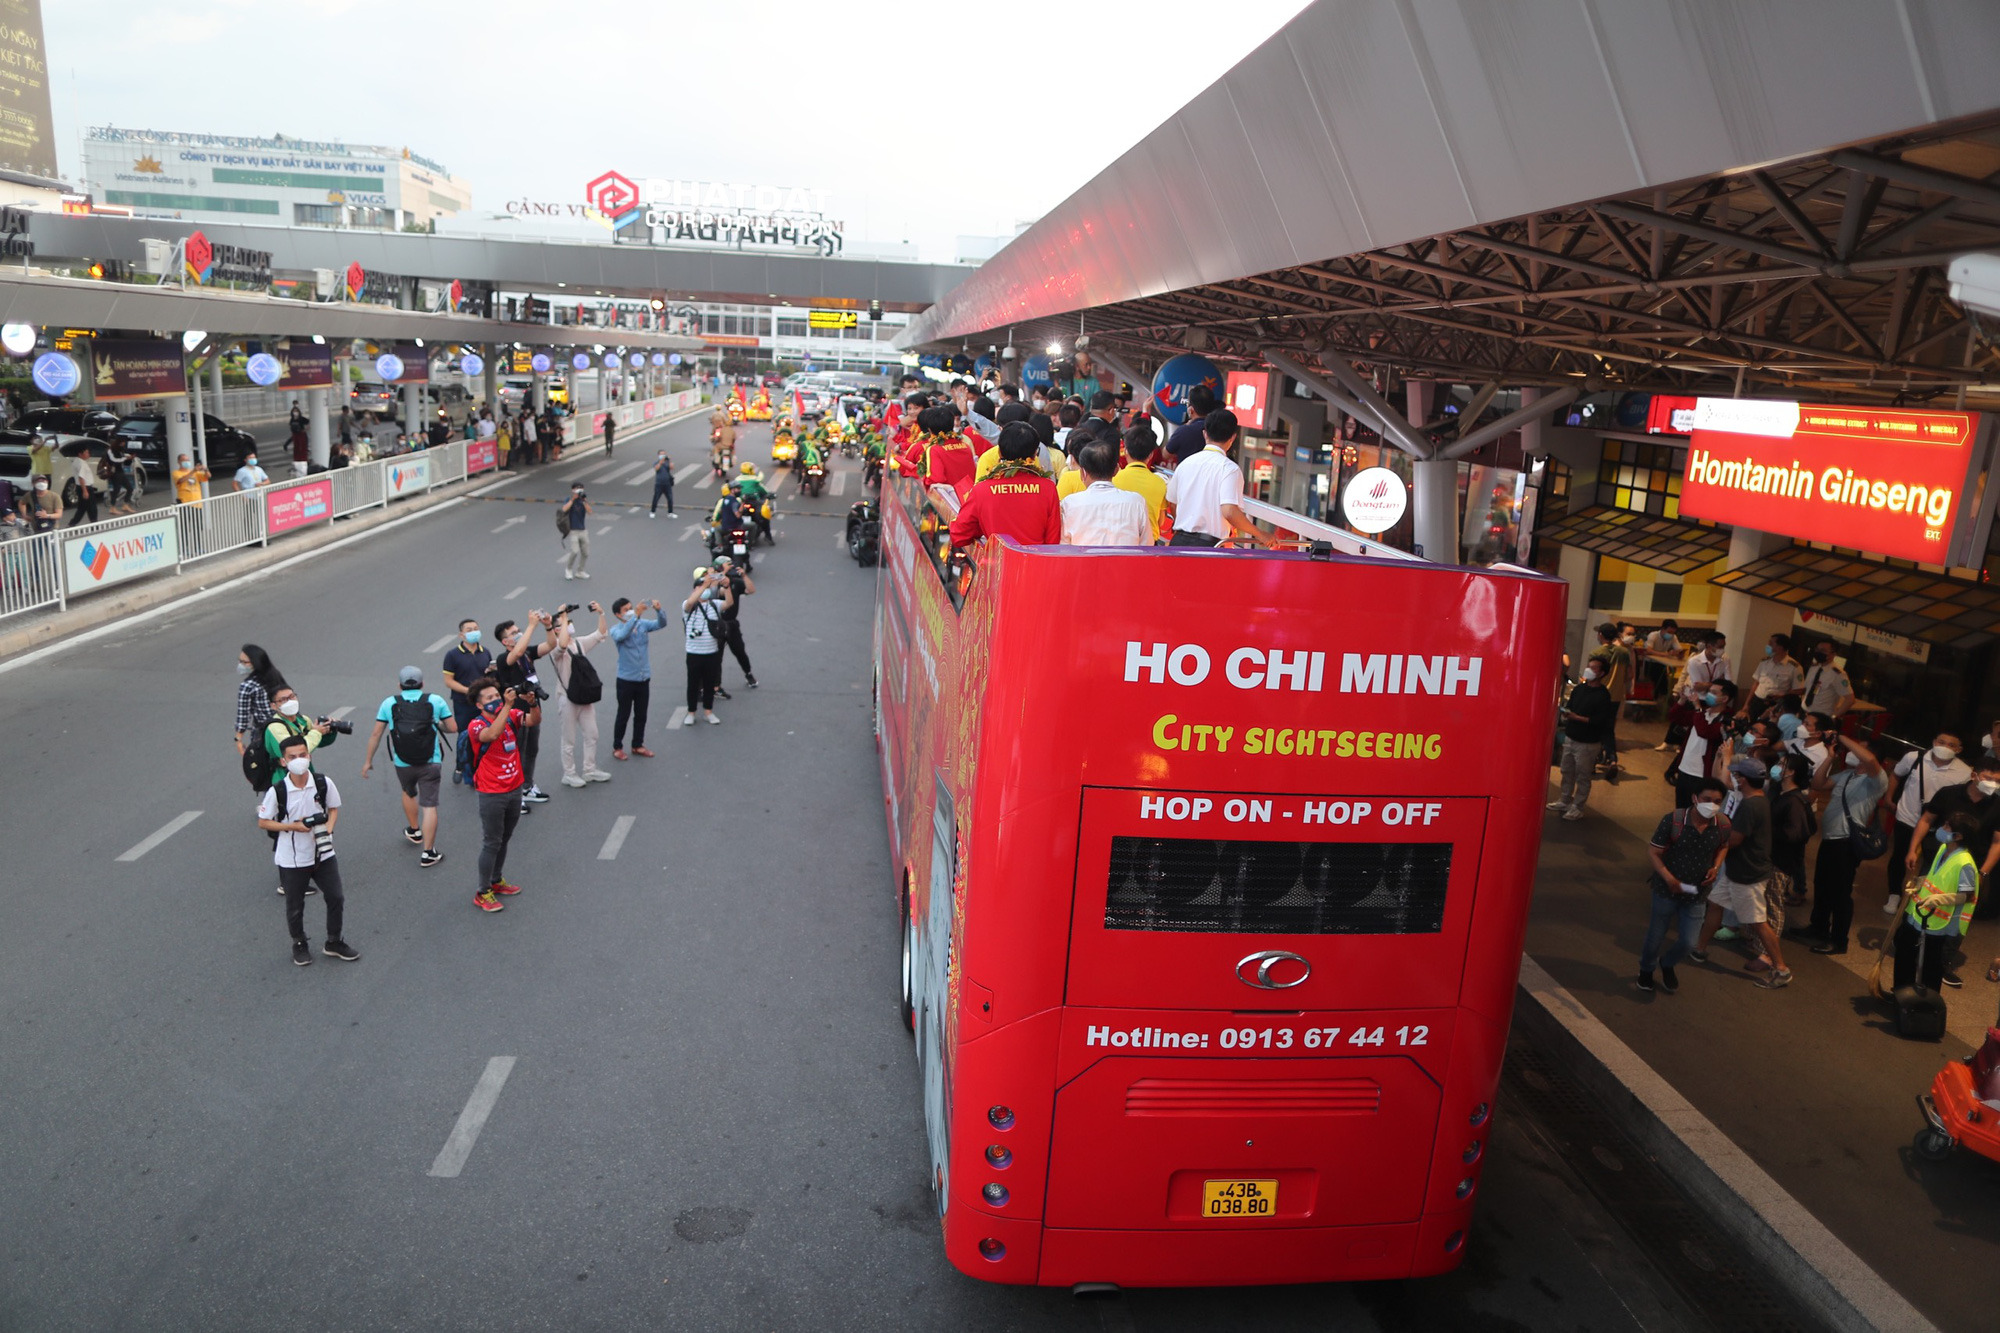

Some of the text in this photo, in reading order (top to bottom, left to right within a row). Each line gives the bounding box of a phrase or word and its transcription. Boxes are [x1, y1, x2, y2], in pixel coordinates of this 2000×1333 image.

[180, 151, 206, 162] CÔNG
[208, 154, 222, 163] TY
[223, 155, 244, 166] DỊCH
[248, 157, 259, 167] VỤ
[324, 162, 342, 171] BAY
[344, 162, 364, 174] VIỆT
[365, 165, 386, 173] NAM
[114, 173, 149, 182] Vietnam
[348, 194, 386, 204] VIAGS
[506, 197, 560, 216] CẢNG
[645, 210, 833, 236] CORPORATION
[212, 243, 273, 268] PHATDAT
[1027, 370, 1049, 380] VIB
[989, 483, 1040, 495] VIETNAM
[1689, 449, 1952, 526] Homtamin Ginseng
[126, 532, 165, 557] VNPAY
[1925, 529, 1942, 541] EXT.
[1124, 641, 1483, 696] HO CHI MINH
[1243, 727, 1442, 760] SIGHTSEEING
[1140, 796, 1213, 820] HOP
[1223, 799, 1273, 822] ON
[1303, 801, 1372, 825] HOP
[1381, 803, 1442, 825] OFF
[1086, 1025, 1430, 1049] Hotline: 0913 67 44 12
[1225, 1183, 1257, 1198] 43B
[1211, 1198, 1269, 1214] 038.80
